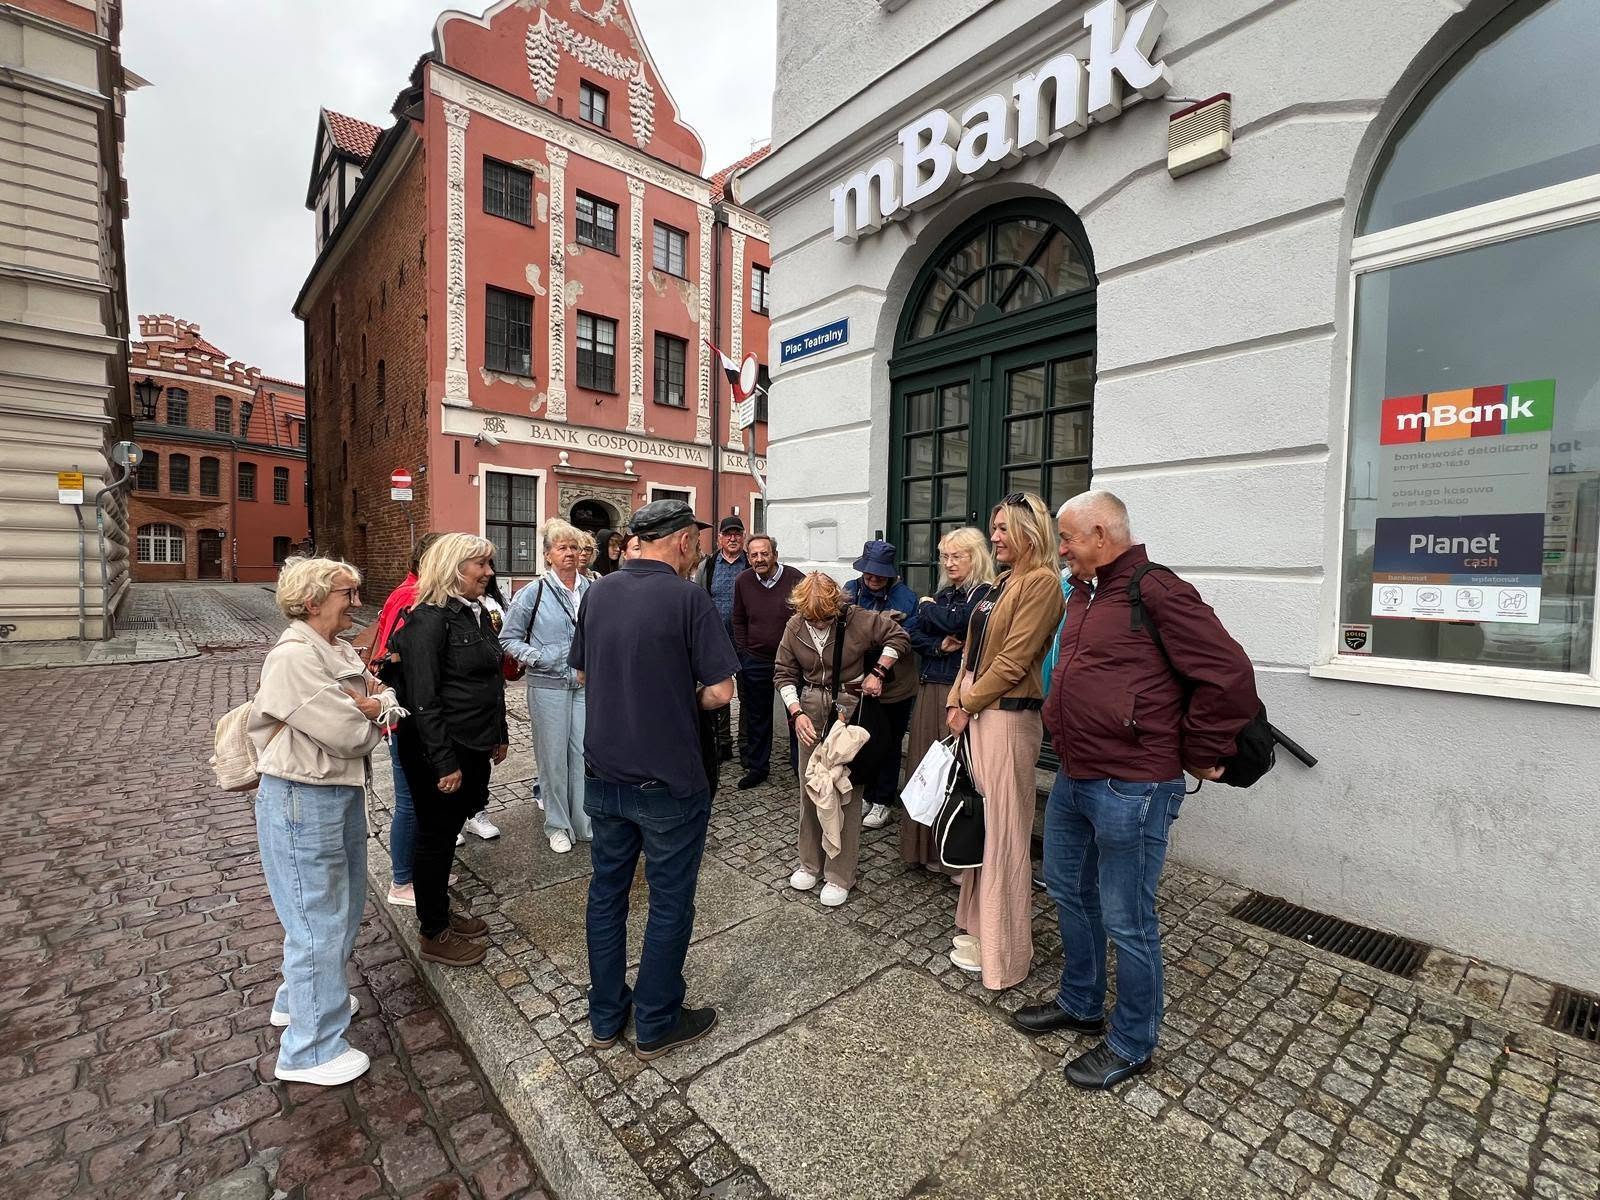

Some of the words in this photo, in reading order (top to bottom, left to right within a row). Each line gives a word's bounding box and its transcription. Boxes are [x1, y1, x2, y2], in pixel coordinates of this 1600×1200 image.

[830, 0, 1171, 244] mBank
[785, 343, 802, 356] Plac
[803, 329, 843, 349] Teatralny
[1396, 395, 1535, 431] mBank
[530, 424, 579, 445] BANK
[587, 433, 703, 463] GOSPODARSTWA
[1409, 533, 1500, 555] Planet
[1463, 556, 1498, 568] cash
